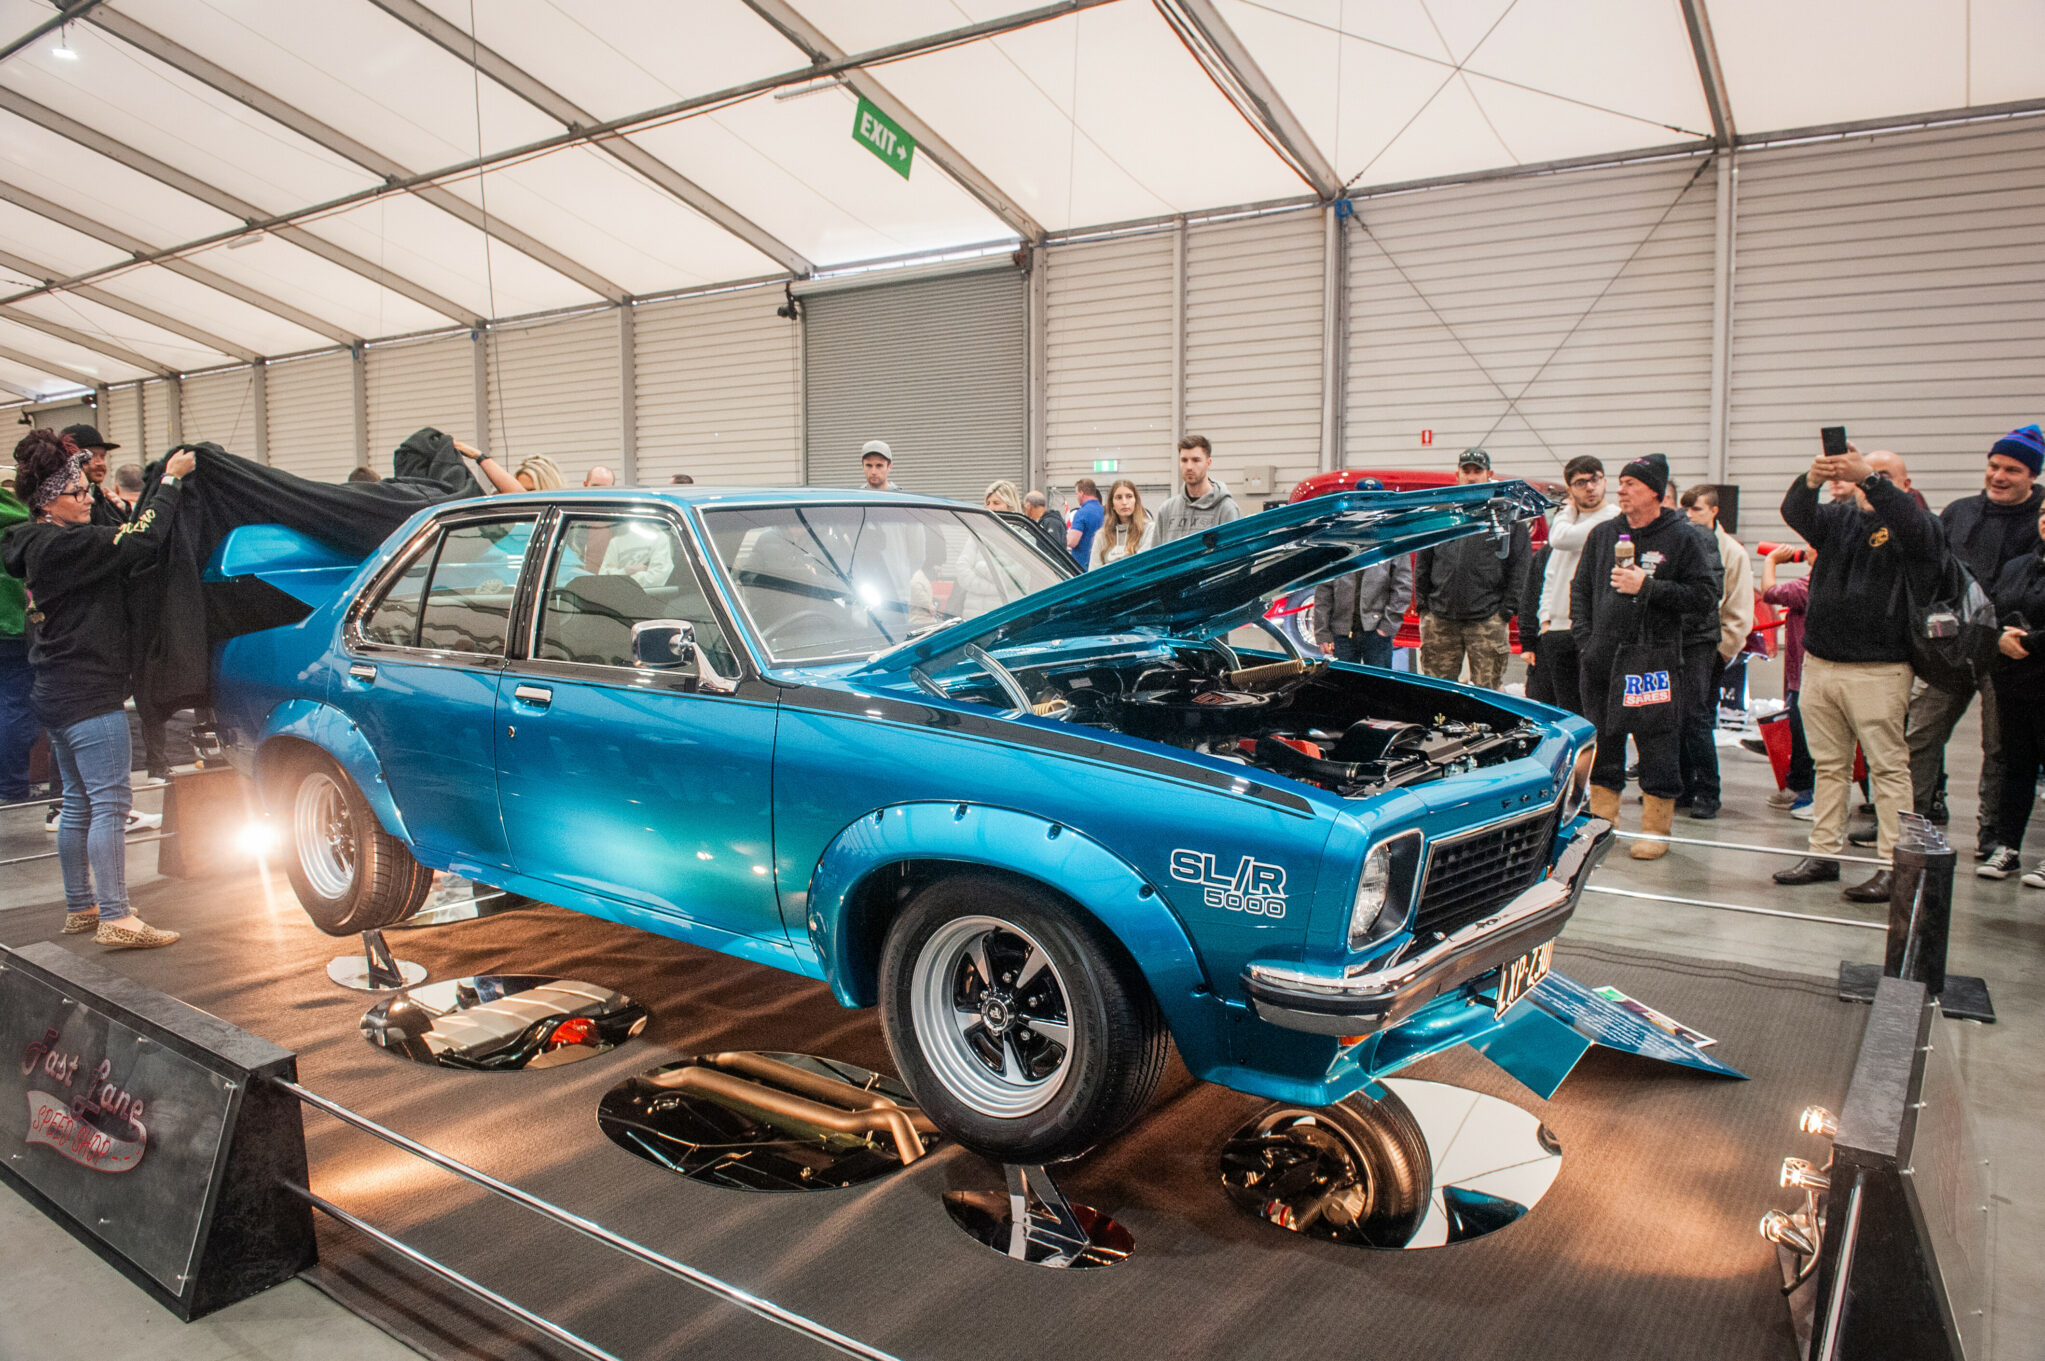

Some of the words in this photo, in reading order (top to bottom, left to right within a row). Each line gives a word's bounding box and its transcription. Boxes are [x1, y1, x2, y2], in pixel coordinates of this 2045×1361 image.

[860, 111, 896, 156] EXIT
[1625, 670, 1669, 695] RRE
[1170, 848, 1289, 898] SL/R
[1204, 887, 1286, 919] 5000
[21, 1027, 79, 1087] Fast
[70, 1058, 144, 1122] Lane
[32, 1104, 74, 1146] SPEED
[71, 1127, 111, 1165] SHOP
